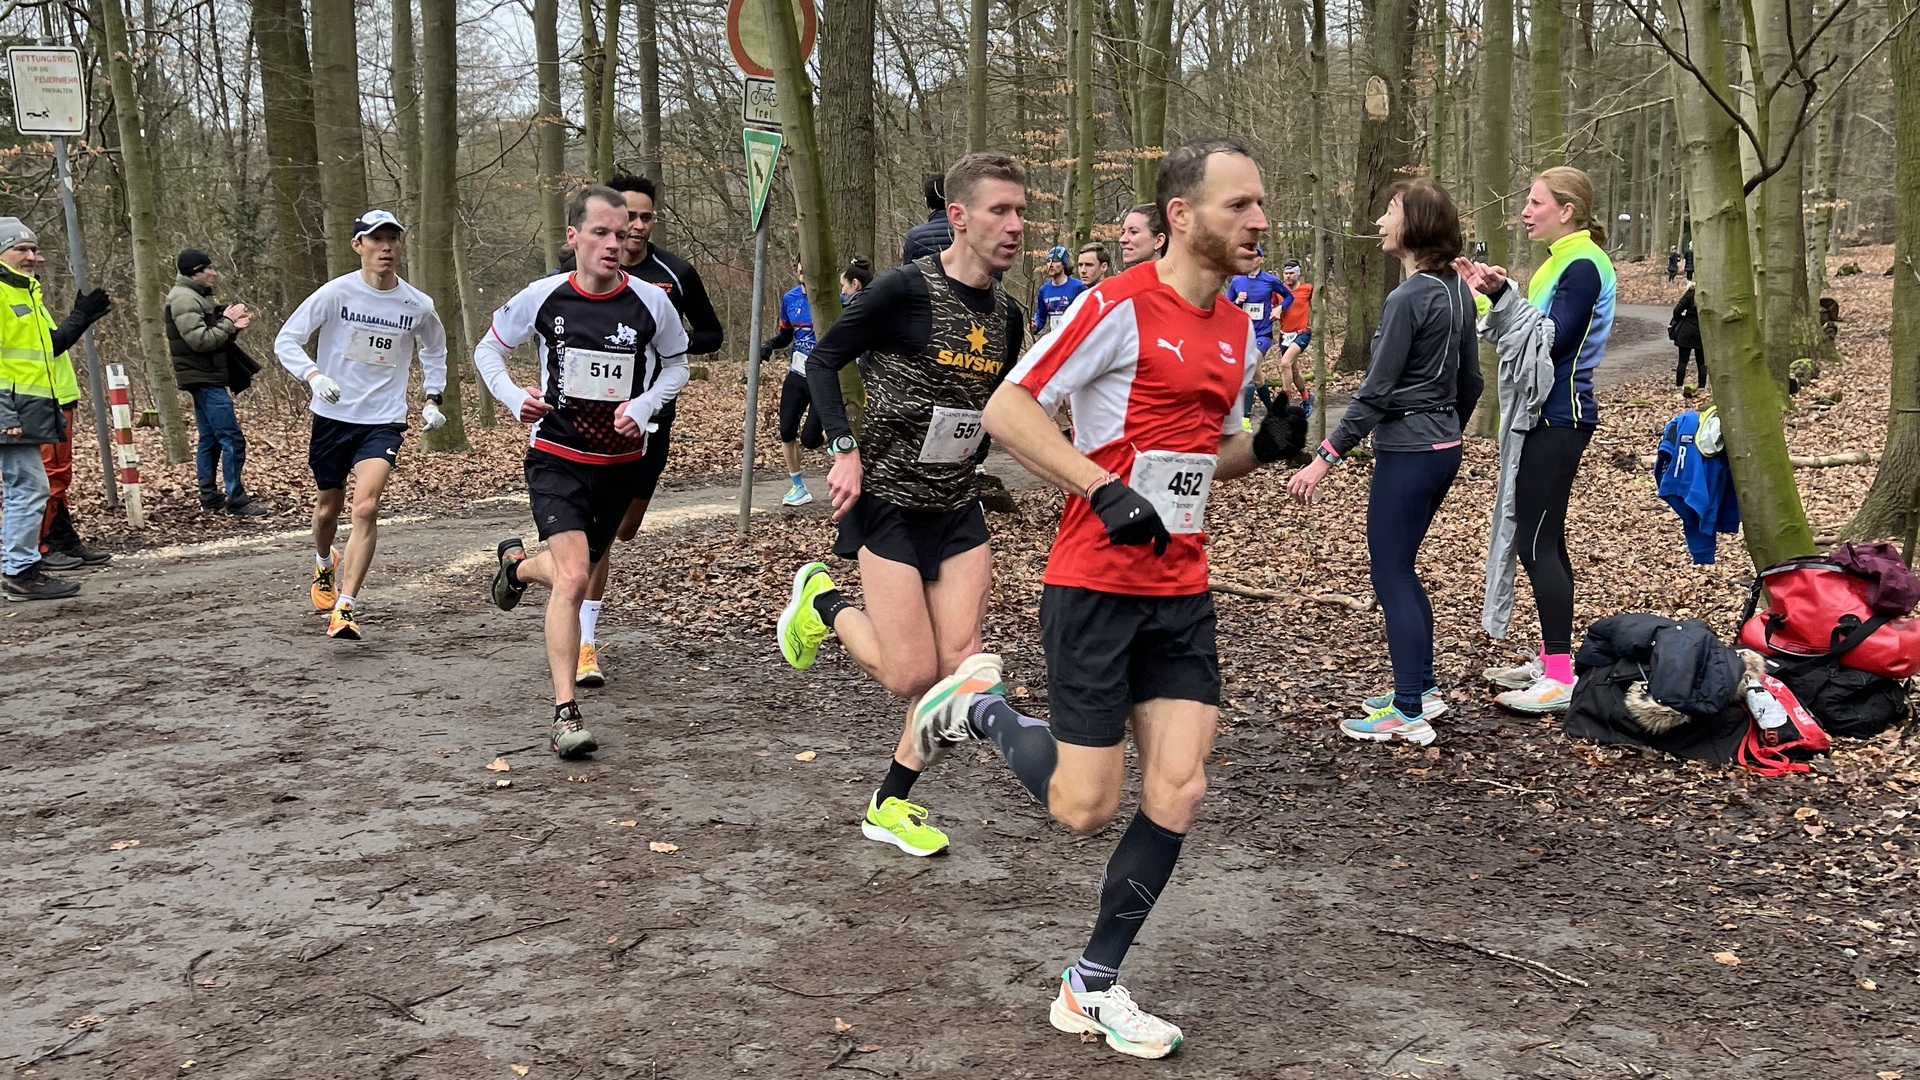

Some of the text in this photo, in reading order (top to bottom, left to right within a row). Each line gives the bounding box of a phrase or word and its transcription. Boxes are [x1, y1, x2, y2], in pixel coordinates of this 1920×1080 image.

[15, 54, 73, 63] RETTUNGSWEG
[34, 76, 79, 84] FEUERWEHR
[755, 108, 772, 119] frei
[368, 335, 393, 350] 168
[590, 361, 623, 379] 514
[936, 349, 1004, 375] SAYSKY
[953, 422, 981, 439] 557
[1167, 471, 1204, 496] 452
